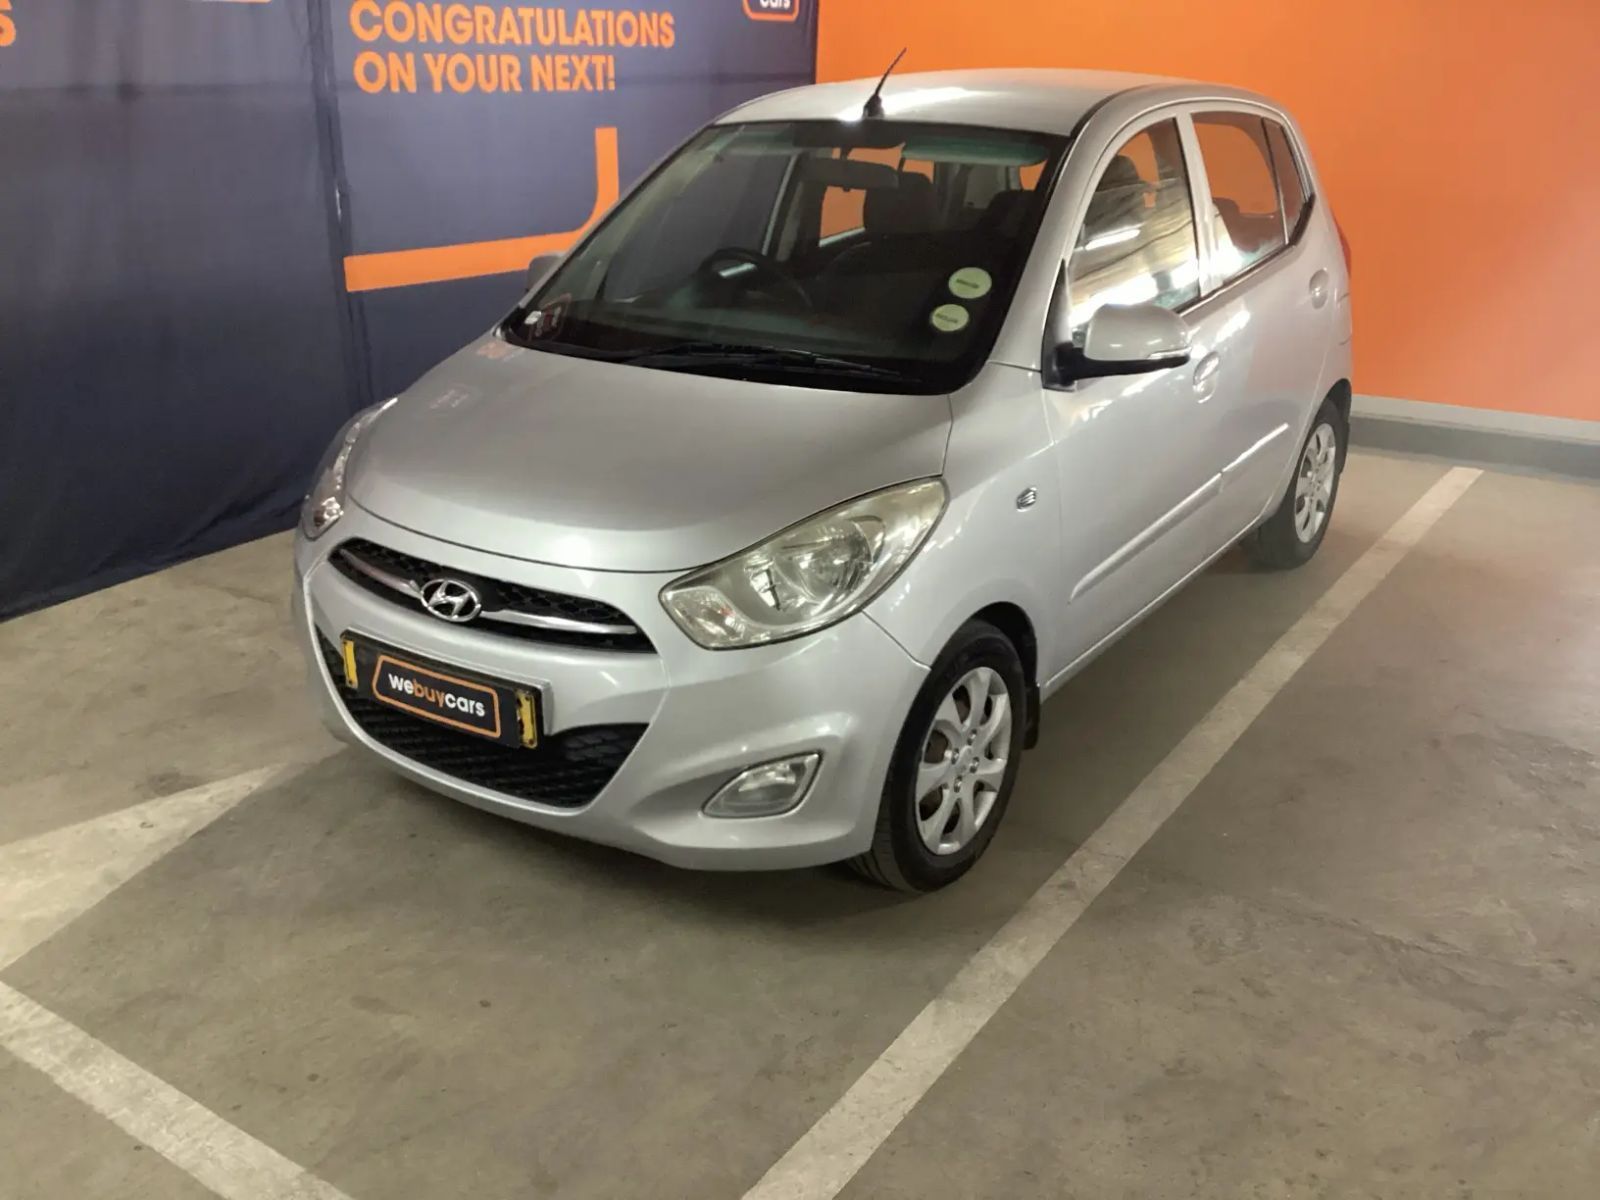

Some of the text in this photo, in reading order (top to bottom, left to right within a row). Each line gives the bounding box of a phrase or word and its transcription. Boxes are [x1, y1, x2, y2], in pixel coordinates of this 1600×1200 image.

[350, 0, 675, 48] CONGRATULATIONS
[353, 50, 616, 93] ON YOUR NEXT!
[388, 673, 485, 717] webuycars
